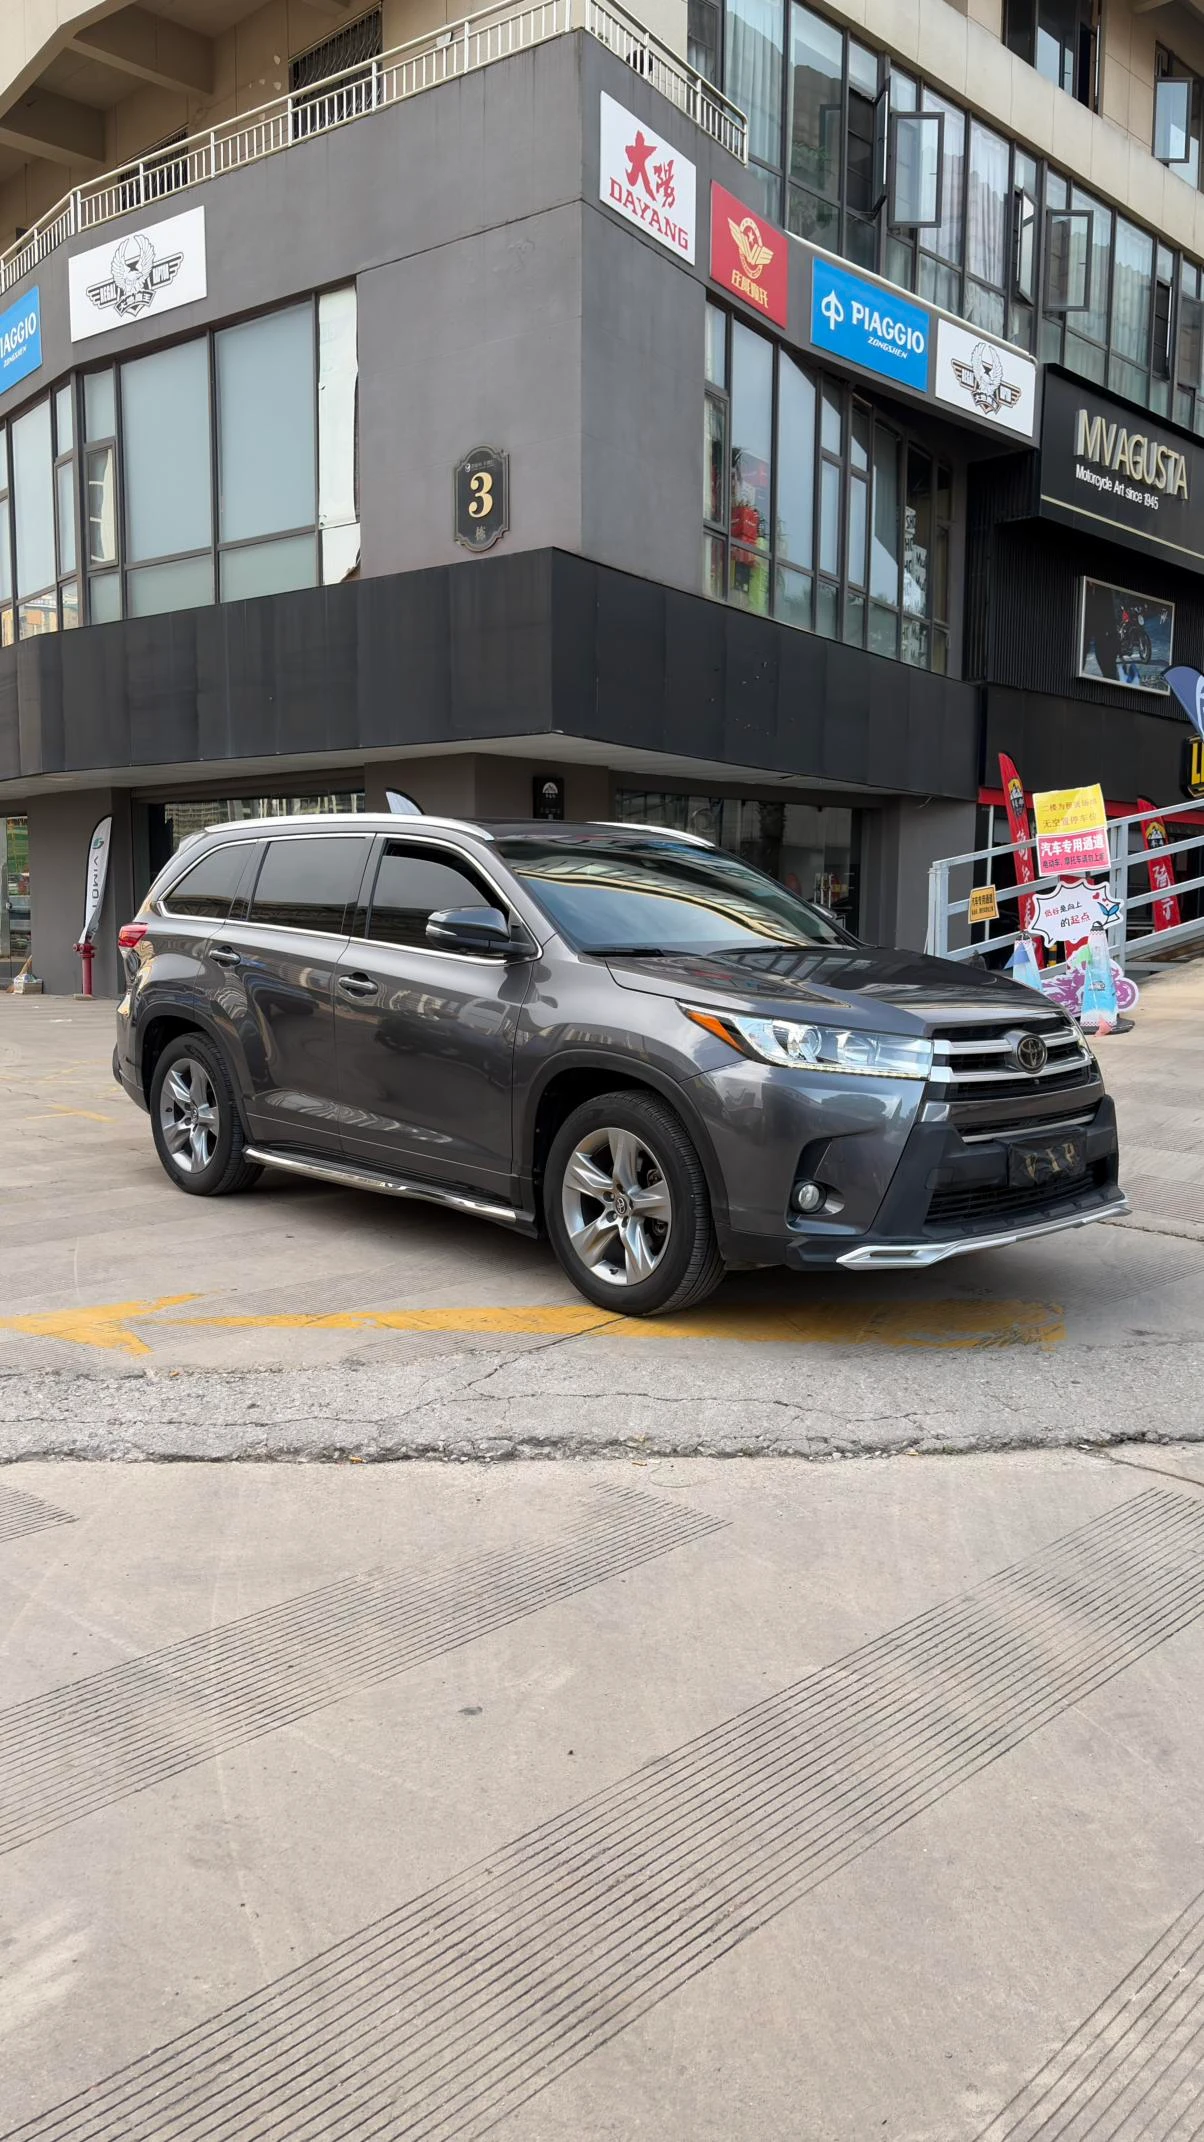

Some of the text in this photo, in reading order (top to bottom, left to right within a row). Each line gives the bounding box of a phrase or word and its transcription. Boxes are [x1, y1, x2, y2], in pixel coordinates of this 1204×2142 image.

[610, 176, 689, 251] DAYANG
[0, 312, 37, 358] IAGGIO
[851, 300, 925, 354] PIAGGIO
[867, 336, 909, 360] ZONGSHEN
[468, 471, 493, 518] 3
[1076, 463, 1159, 510] Motorcycle Art since 1945
[1041, 833, 1105, 857] 汽车专用通道
[1060, 911, 1091, 928] 的起点
